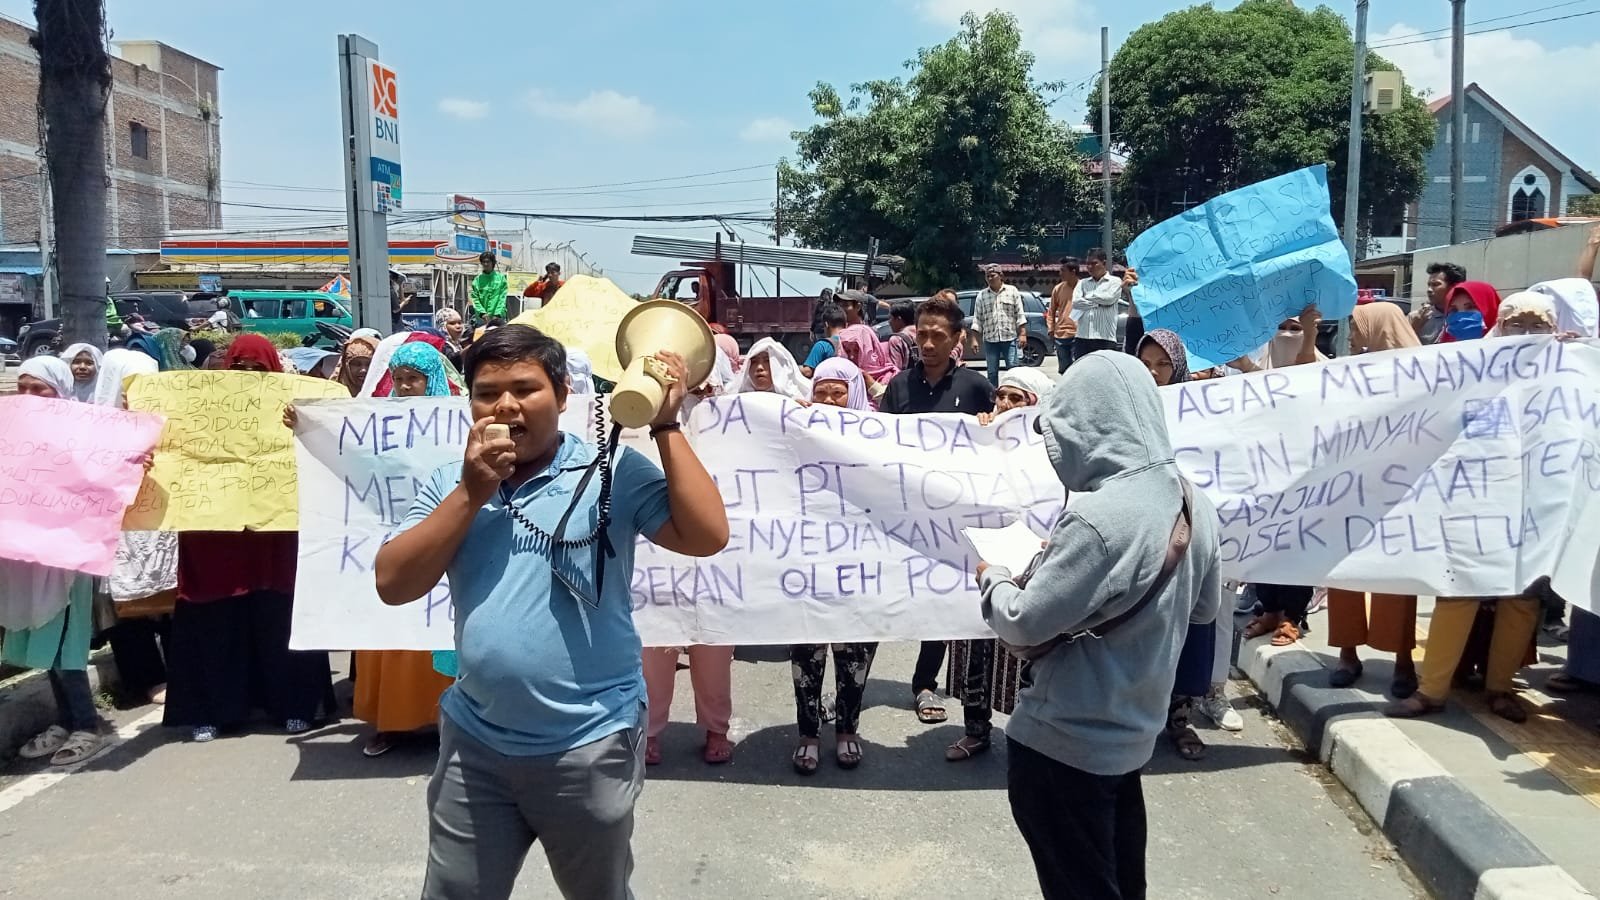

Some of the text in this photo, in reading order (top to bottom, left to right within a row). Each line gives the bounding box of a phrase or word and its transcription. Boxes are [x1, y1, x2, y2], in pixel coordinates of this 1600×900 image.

[376, 117, 399, 144] BNI
[377, 162, 391, 175] ATM
[138, 373, 226, 395] TANGKAP
[781, 399, 977, 455] KAPOLDA
[1177, 372, 1297, 423] AGAR
[1320, 343, 1585, 405] MEMANGGIL
[185, 414, 260, 434] DIDUGA
[713, 468, 779, 515] UT
[795, 461, 872, 517] PT.
[883, 462, 1060, 513] TOTAL
[1174, 432, 1292, 493] GUN
[1312, 408, 1443, 468] MINYAK
[1523, 386, 1600, 434] SAW
[170, 479, 209, 493] OLEH
[721, 517, 958, 559] ENYEDIAKAN
[1216, 491, 1285, 528] KASI
[1281, 470, 1365, 516] JUDI
[1381, 456, 1508, 506] SAAT
[630, 561, 744, 611] BEKAN
[780, 561, 881, 599] OLEH
[903, 553, 979, 599] POL
[1219, 516, 1327, 562] OLSEK
